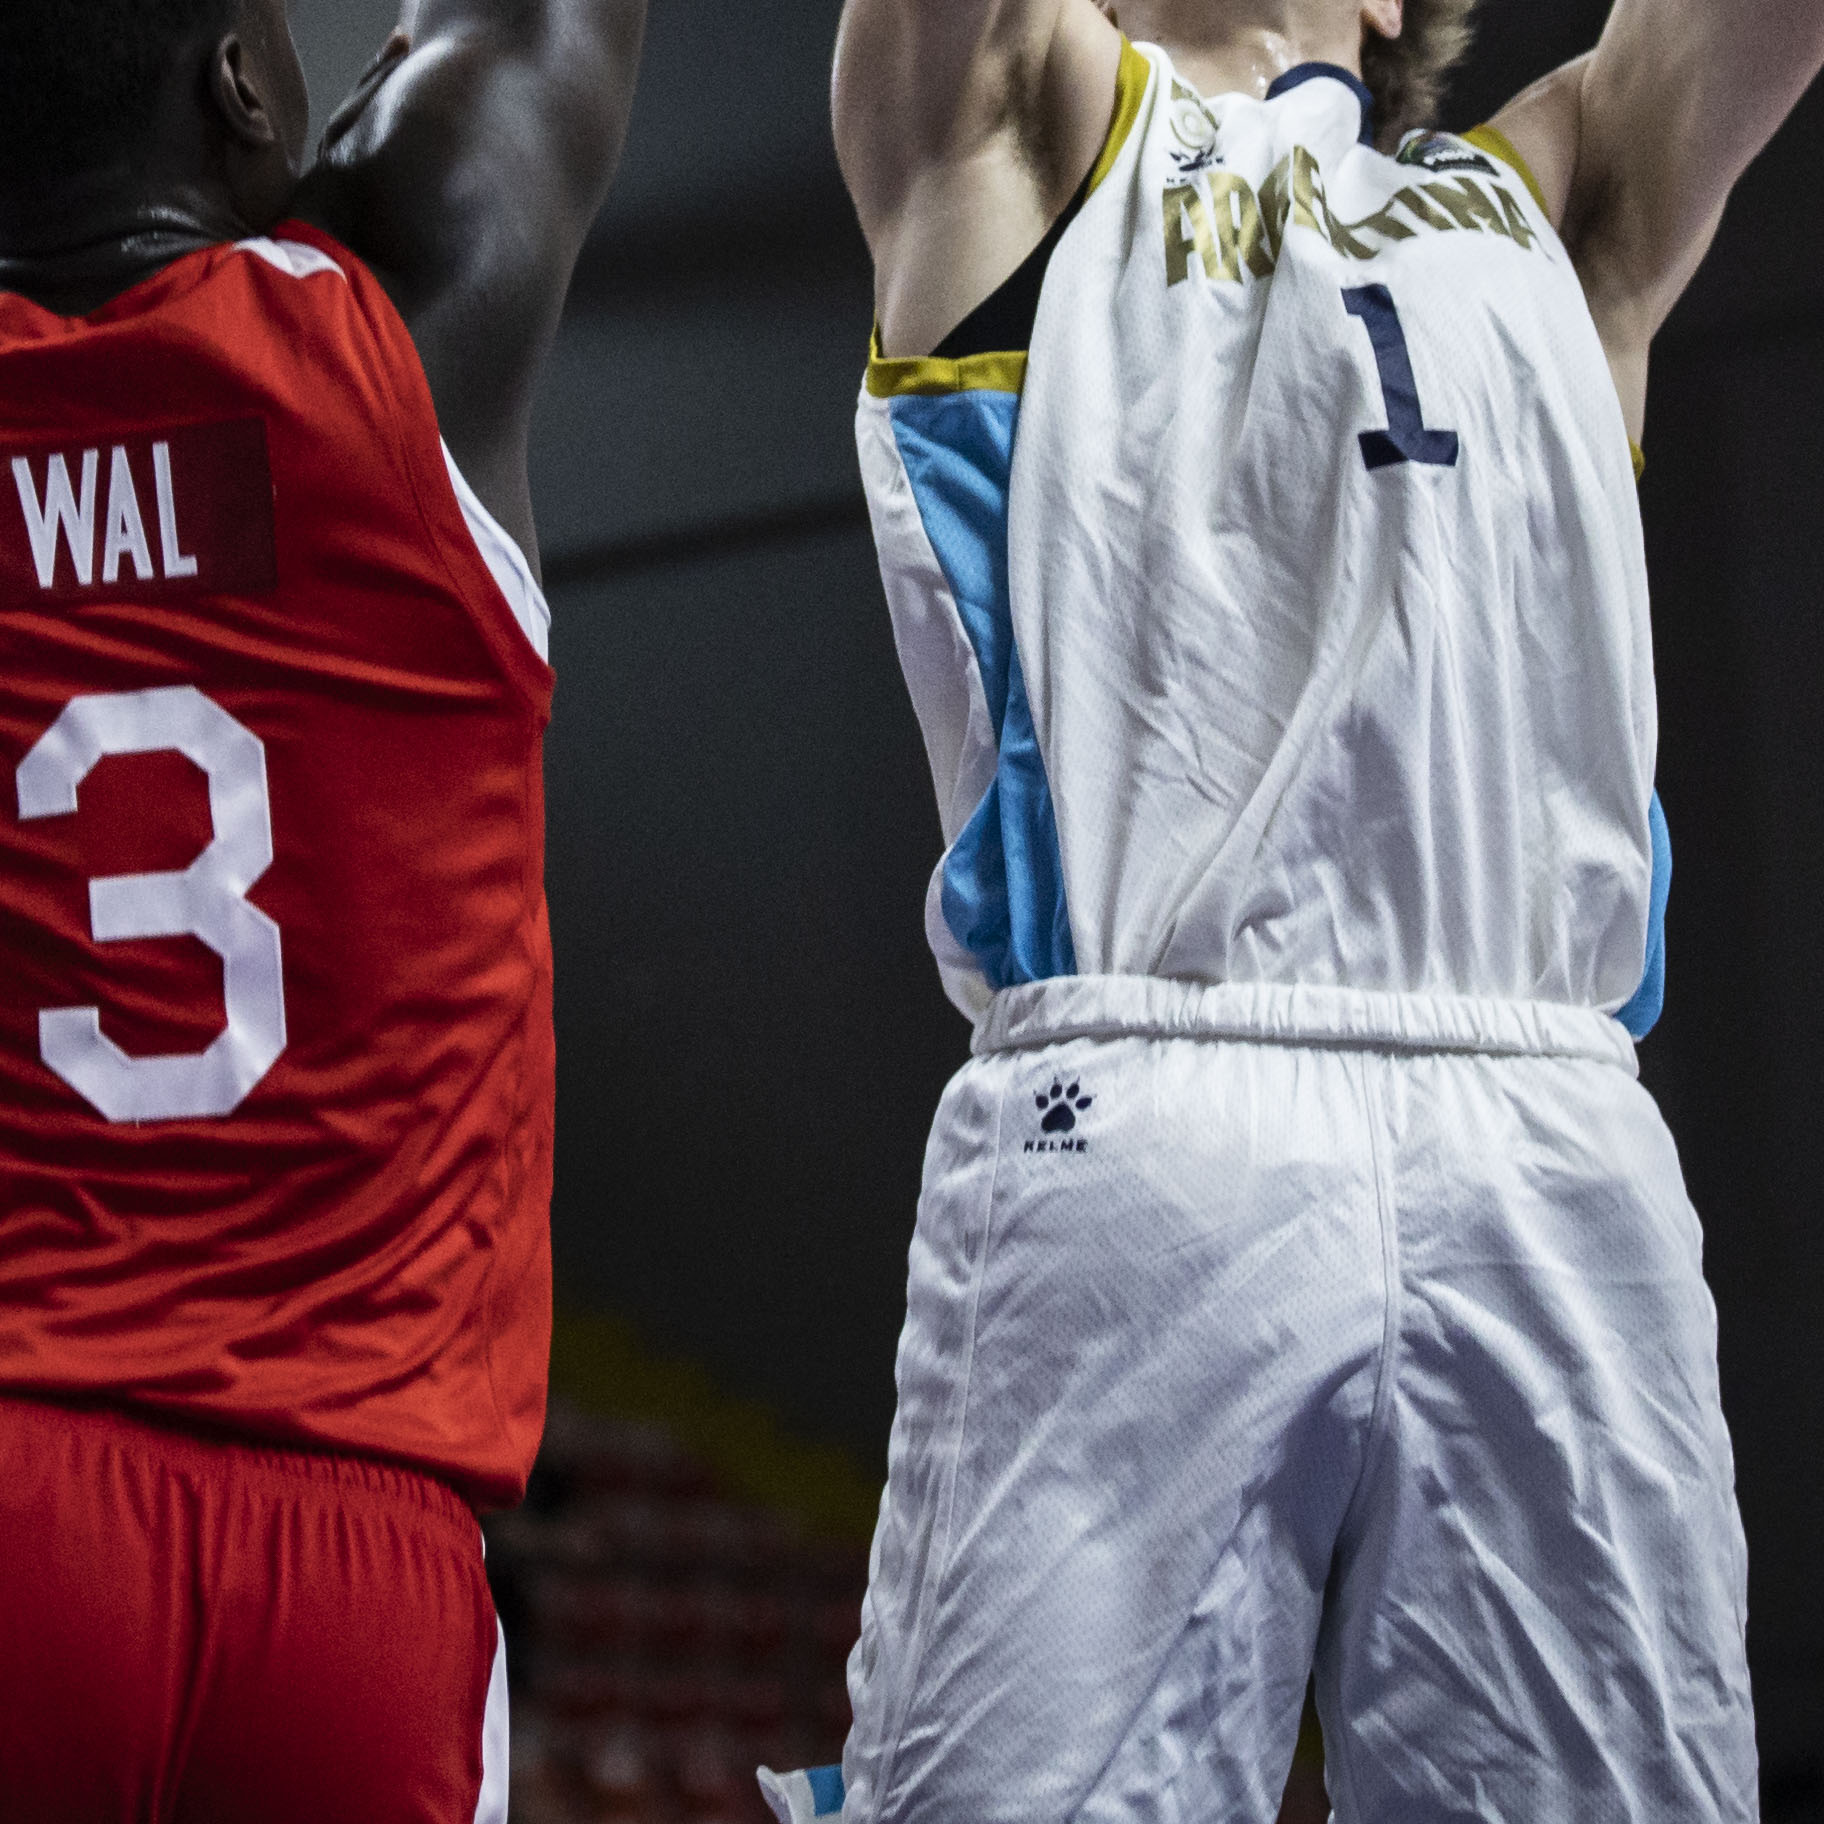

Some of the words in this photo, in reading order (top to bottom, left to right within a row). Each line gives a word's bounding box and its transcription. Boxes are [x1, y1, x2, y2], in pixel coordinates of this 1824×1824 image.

[1341, 283, 1459, 472] 1
[12, 442, 197, 588] WAL
[16, 684, 287, 1122] 3
[1024, 1138, 1088, 1153] KELME
